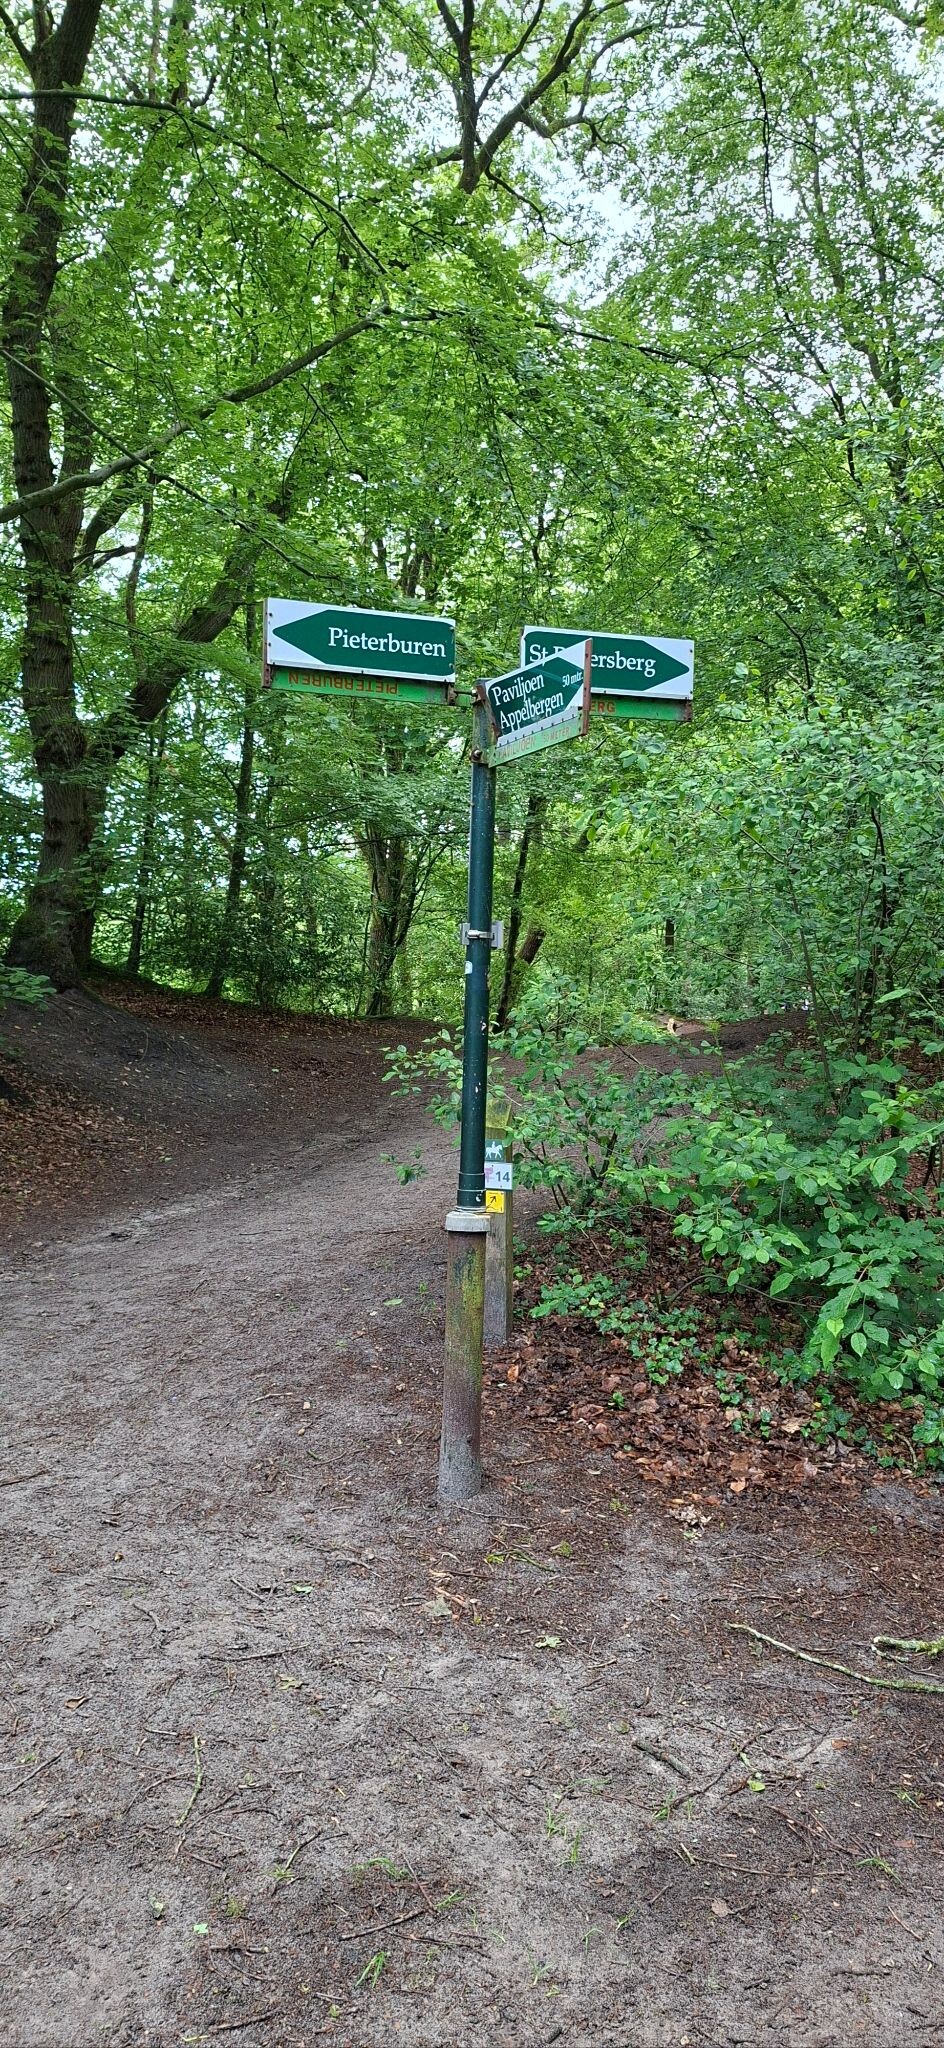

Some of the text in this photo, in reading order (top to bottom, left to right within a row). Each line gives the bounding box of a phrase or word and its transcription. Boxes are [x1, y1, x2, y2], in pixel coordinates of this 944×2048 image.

[328, 627, 447, 657] Pieterburen
[553, 645, 656, 677] ersberg
[288, 671, 398, 695] PIETERBUREN
[491, 672, 545, 706] Paviljoen
[562, 671, 584, 688] 50 mtr.
[499, 692, 564, 732] Appelbergen
[495, 1170, 510, 1183] 14
